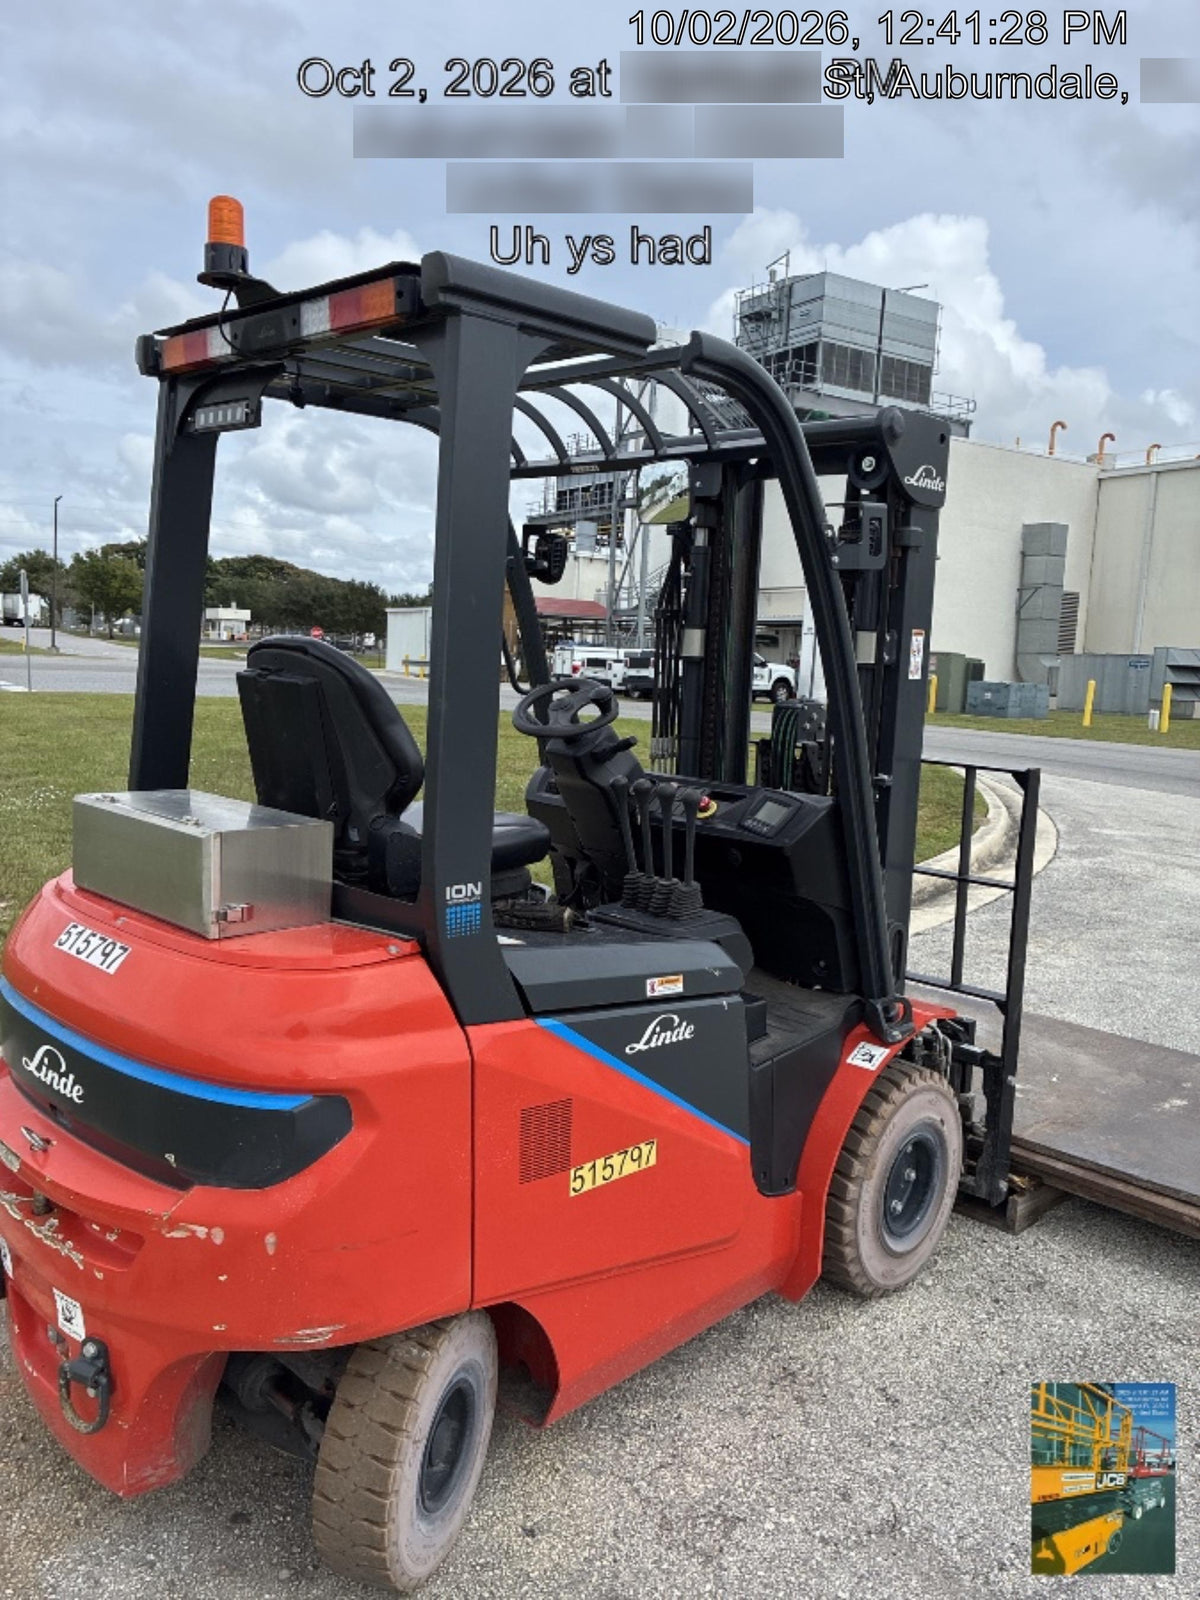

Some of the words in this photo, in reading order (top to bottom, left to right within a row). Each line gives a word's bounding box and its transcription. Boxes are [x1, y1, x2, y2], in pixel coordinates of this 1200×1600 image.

[905, 464, 945, 492] Linde
[445, 881, 482, 900] ION
[57, 924, 129, 970] 515797
[625, 1013, 695, 1055] Linde
[21, 1044, 85, 1104] Linde
[571, 1140, 656, 1194] 515797
